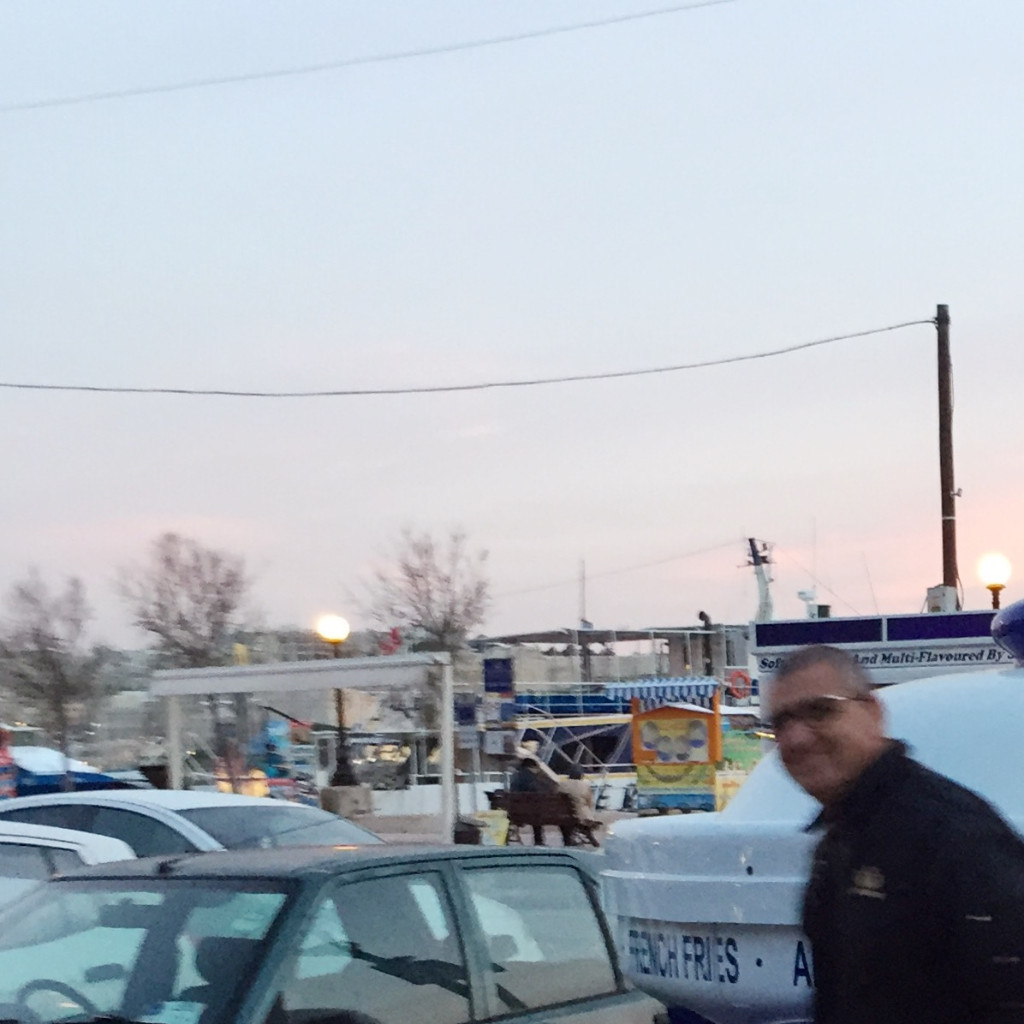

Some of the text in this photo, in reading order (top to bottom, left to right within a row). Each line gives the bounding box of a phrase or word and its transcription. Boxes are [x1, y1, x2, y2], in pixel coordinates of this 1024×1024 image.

[880, 649, 985, 664] Multi-Flavoured
[987, 648, 1005, 662] By
[629, 929, 679, 979] FRENCH
[682, 935, 740, 984] FRIES
